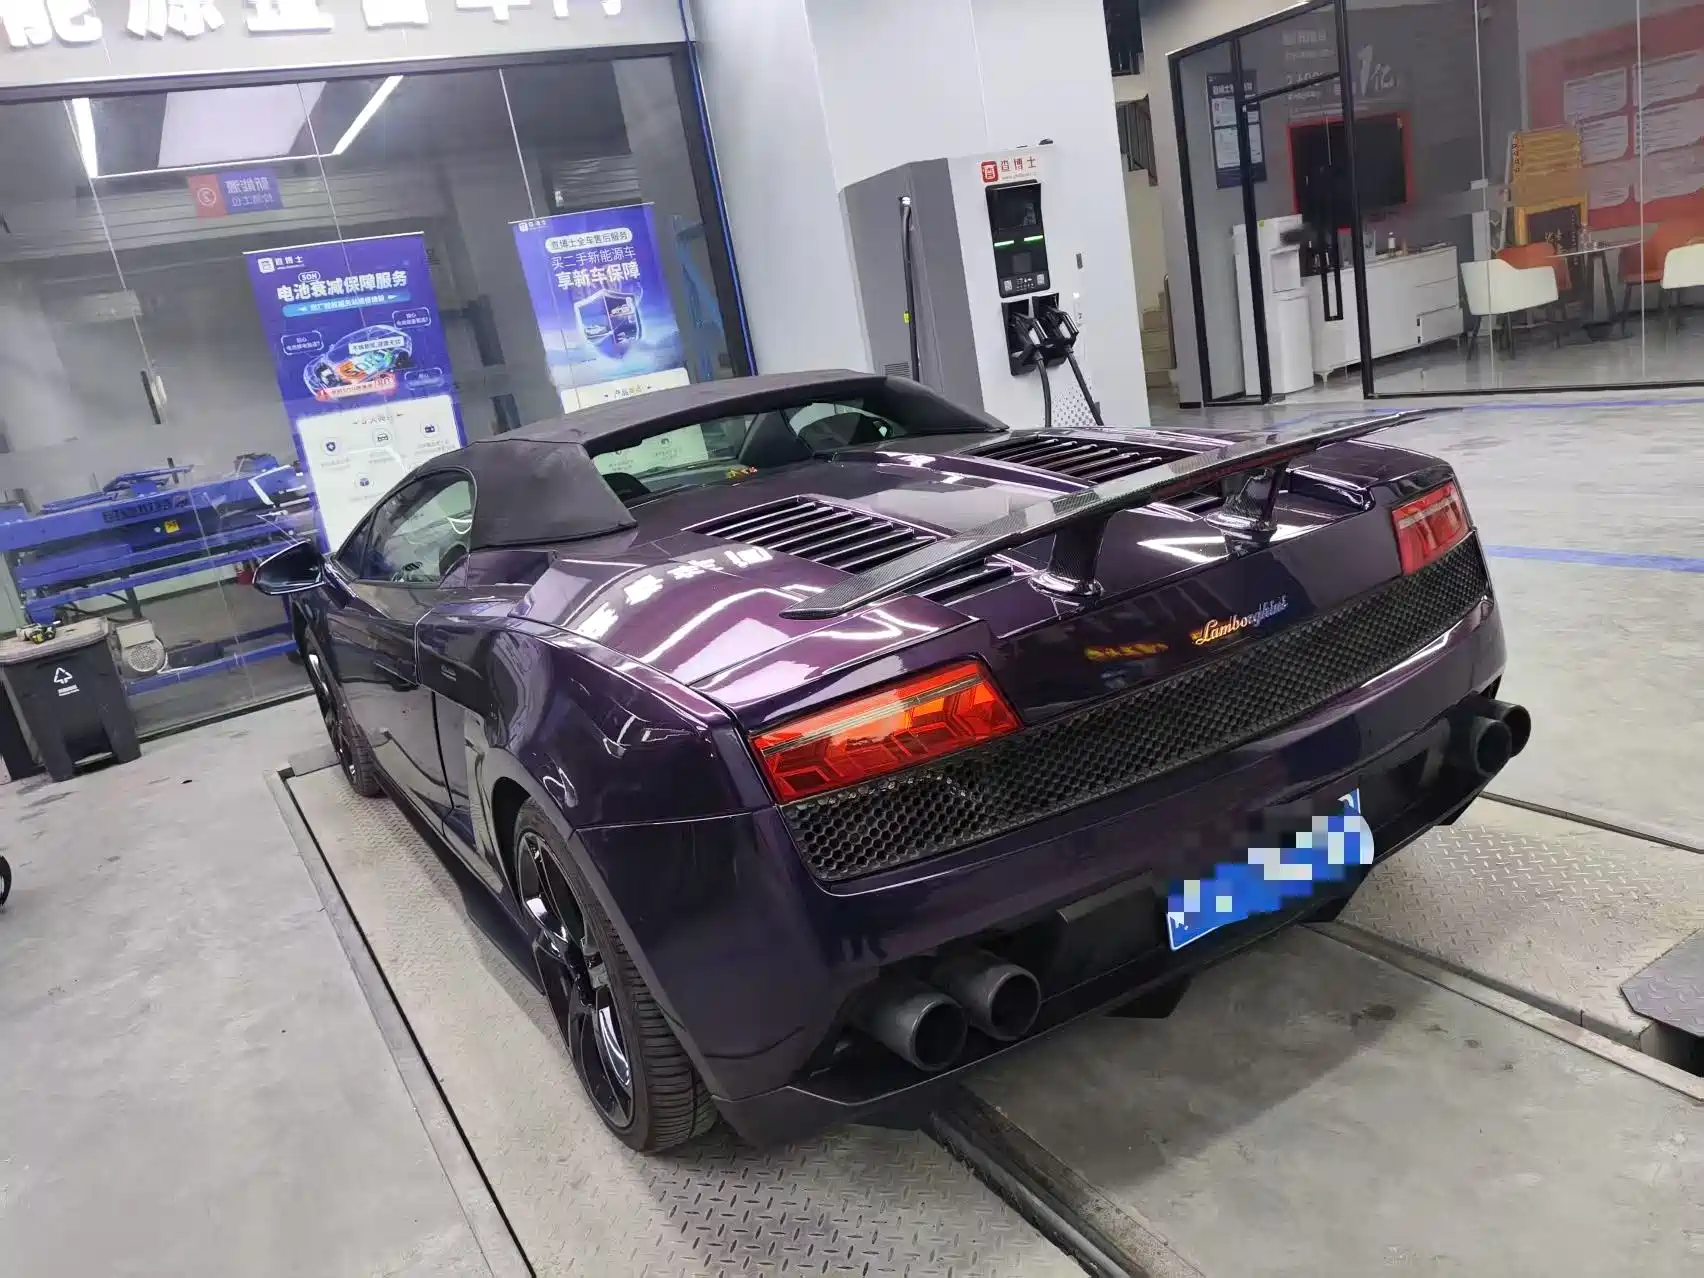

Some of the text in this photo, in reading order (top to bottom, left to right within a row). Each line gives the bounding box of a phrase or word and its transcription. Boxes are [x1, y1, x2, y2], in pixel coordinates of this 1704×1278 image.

[1001, 156, 1037, 172] 查博士
[551, 246, 637, 269] 买二手新能源车
[276, 270, 408, 302] 电池衰减保障服务
[556, 260, 641, 290] 享新车保障
